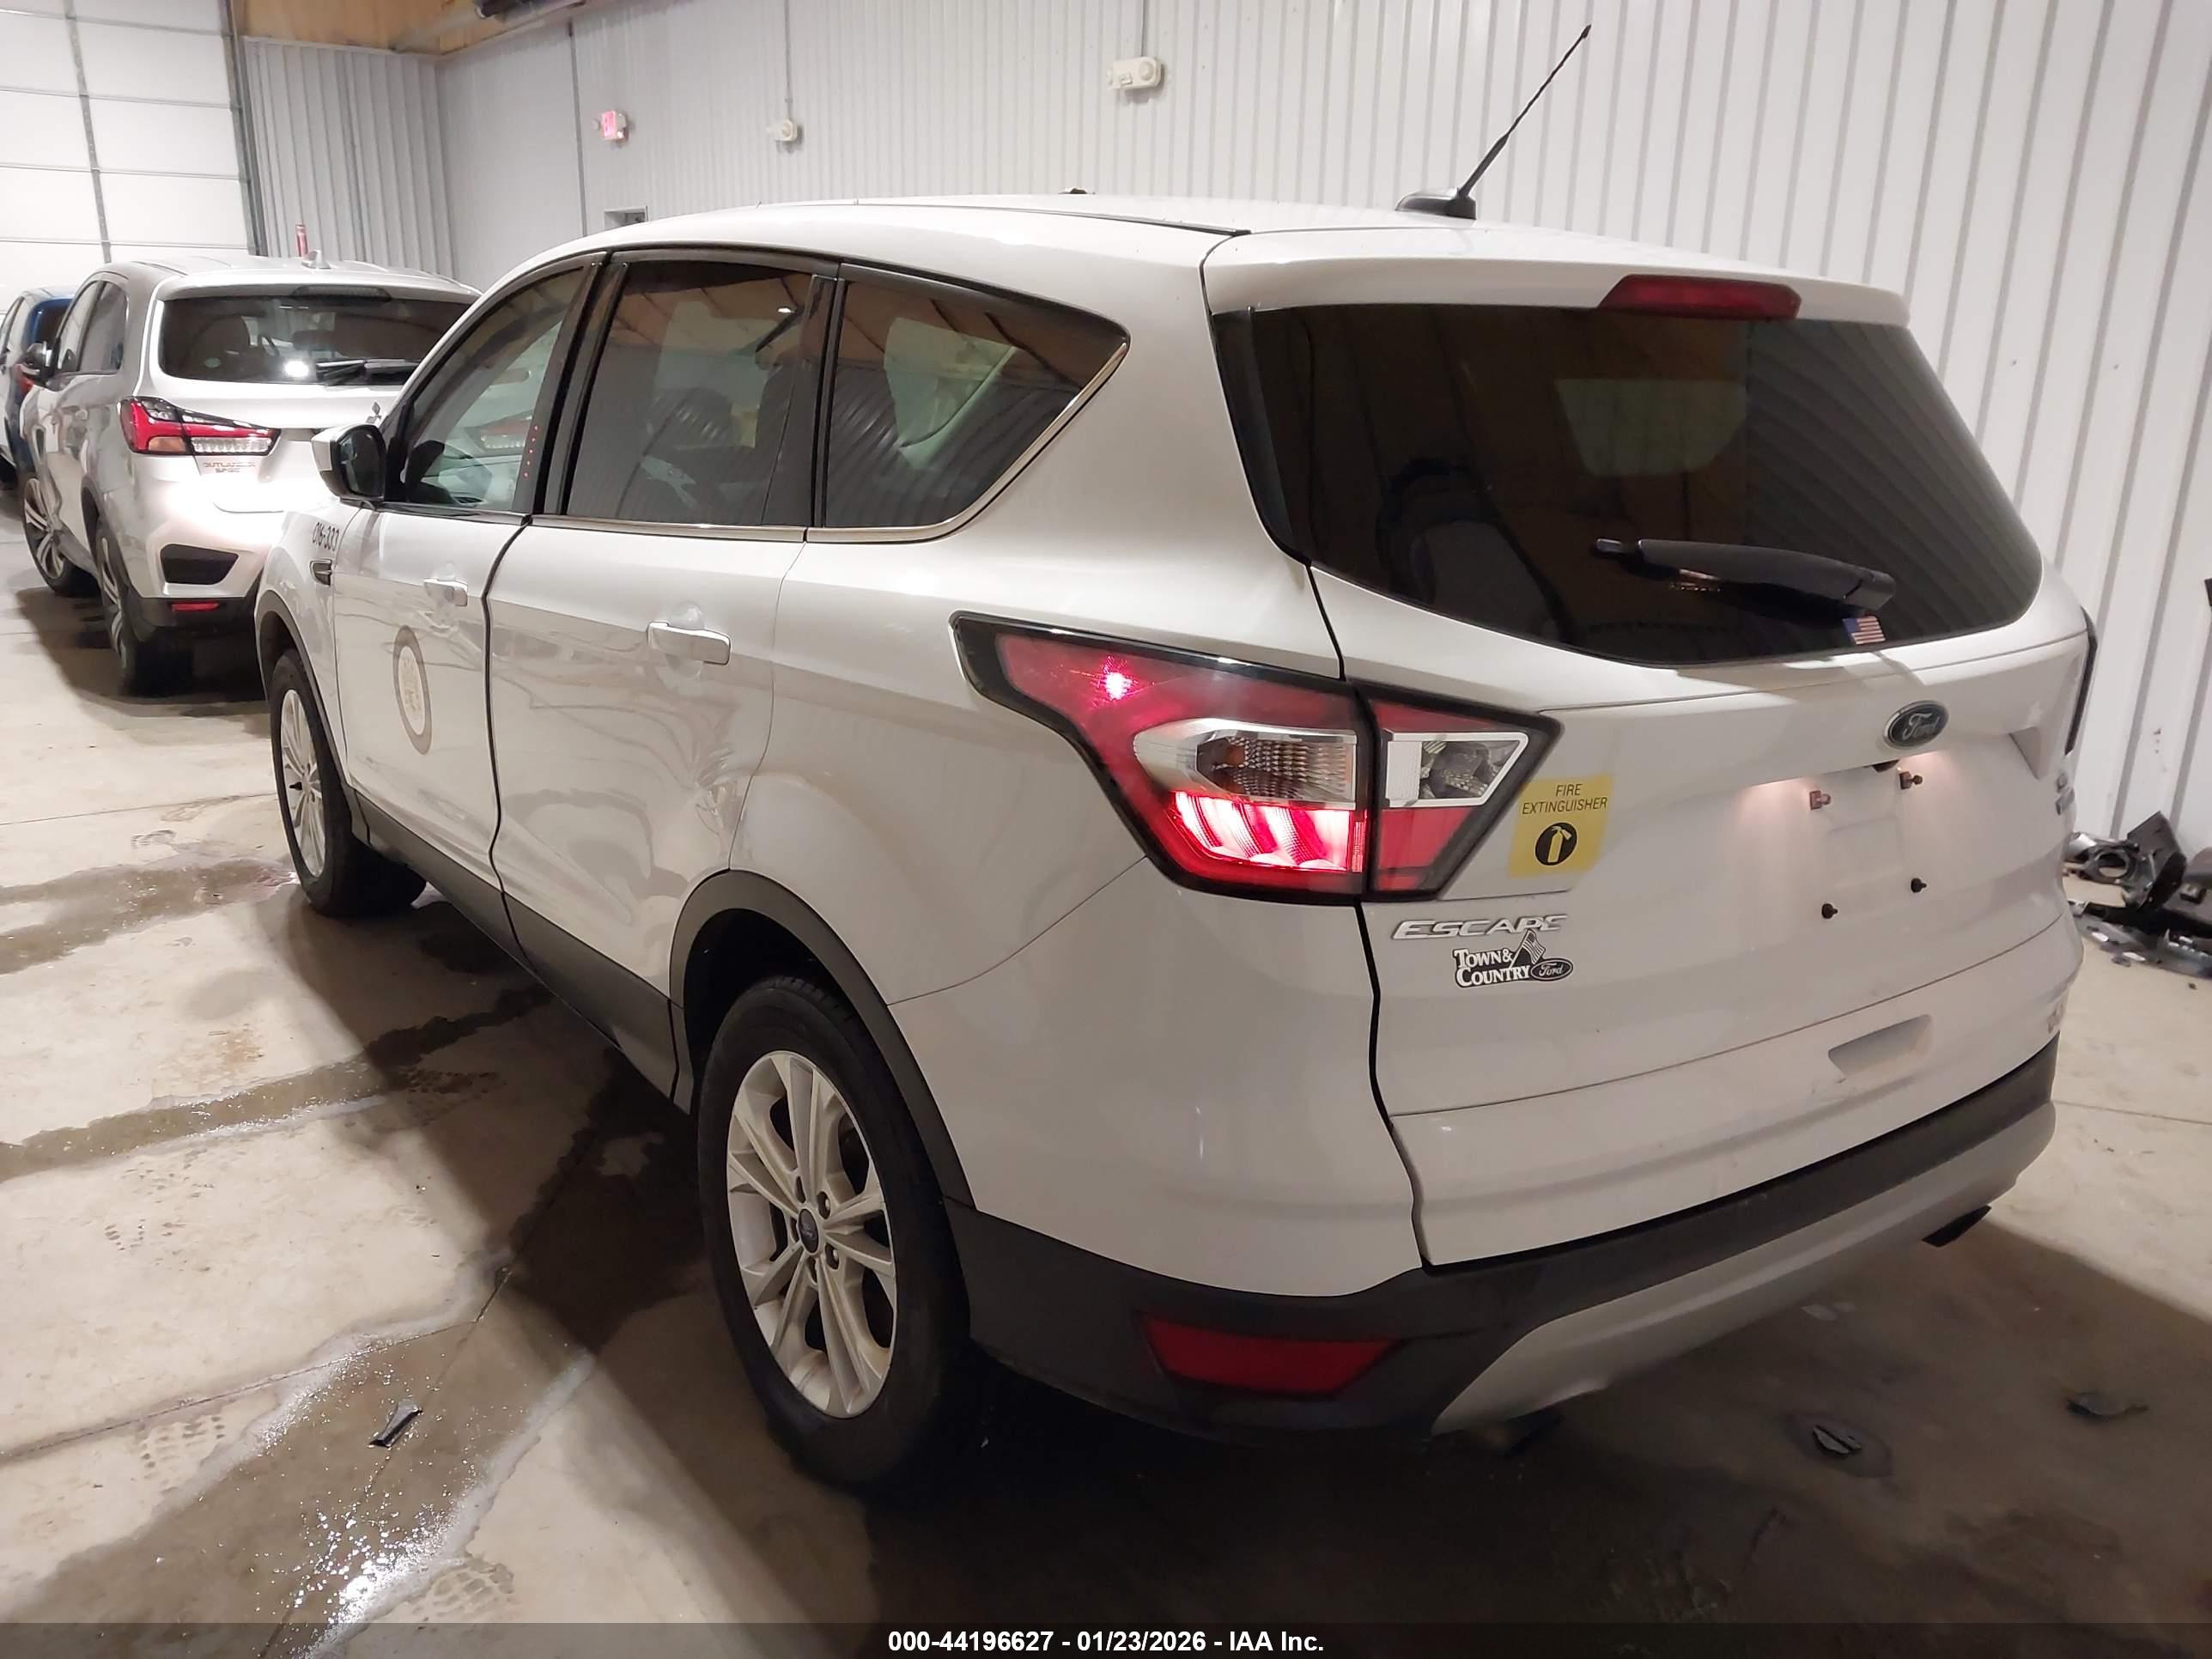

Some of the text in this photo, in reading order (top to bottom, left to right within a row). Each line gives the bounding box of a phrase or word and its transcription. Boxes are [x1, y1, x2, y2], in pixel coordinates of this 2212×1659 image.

[1555, 783, 1583, 797] FIRE
[1522, 797, 1608, 815] EXTINGUISHER
[1392, 914, 1568, 939] ESCAPE
[1456, 964, 1531, 988] COUNTRY
